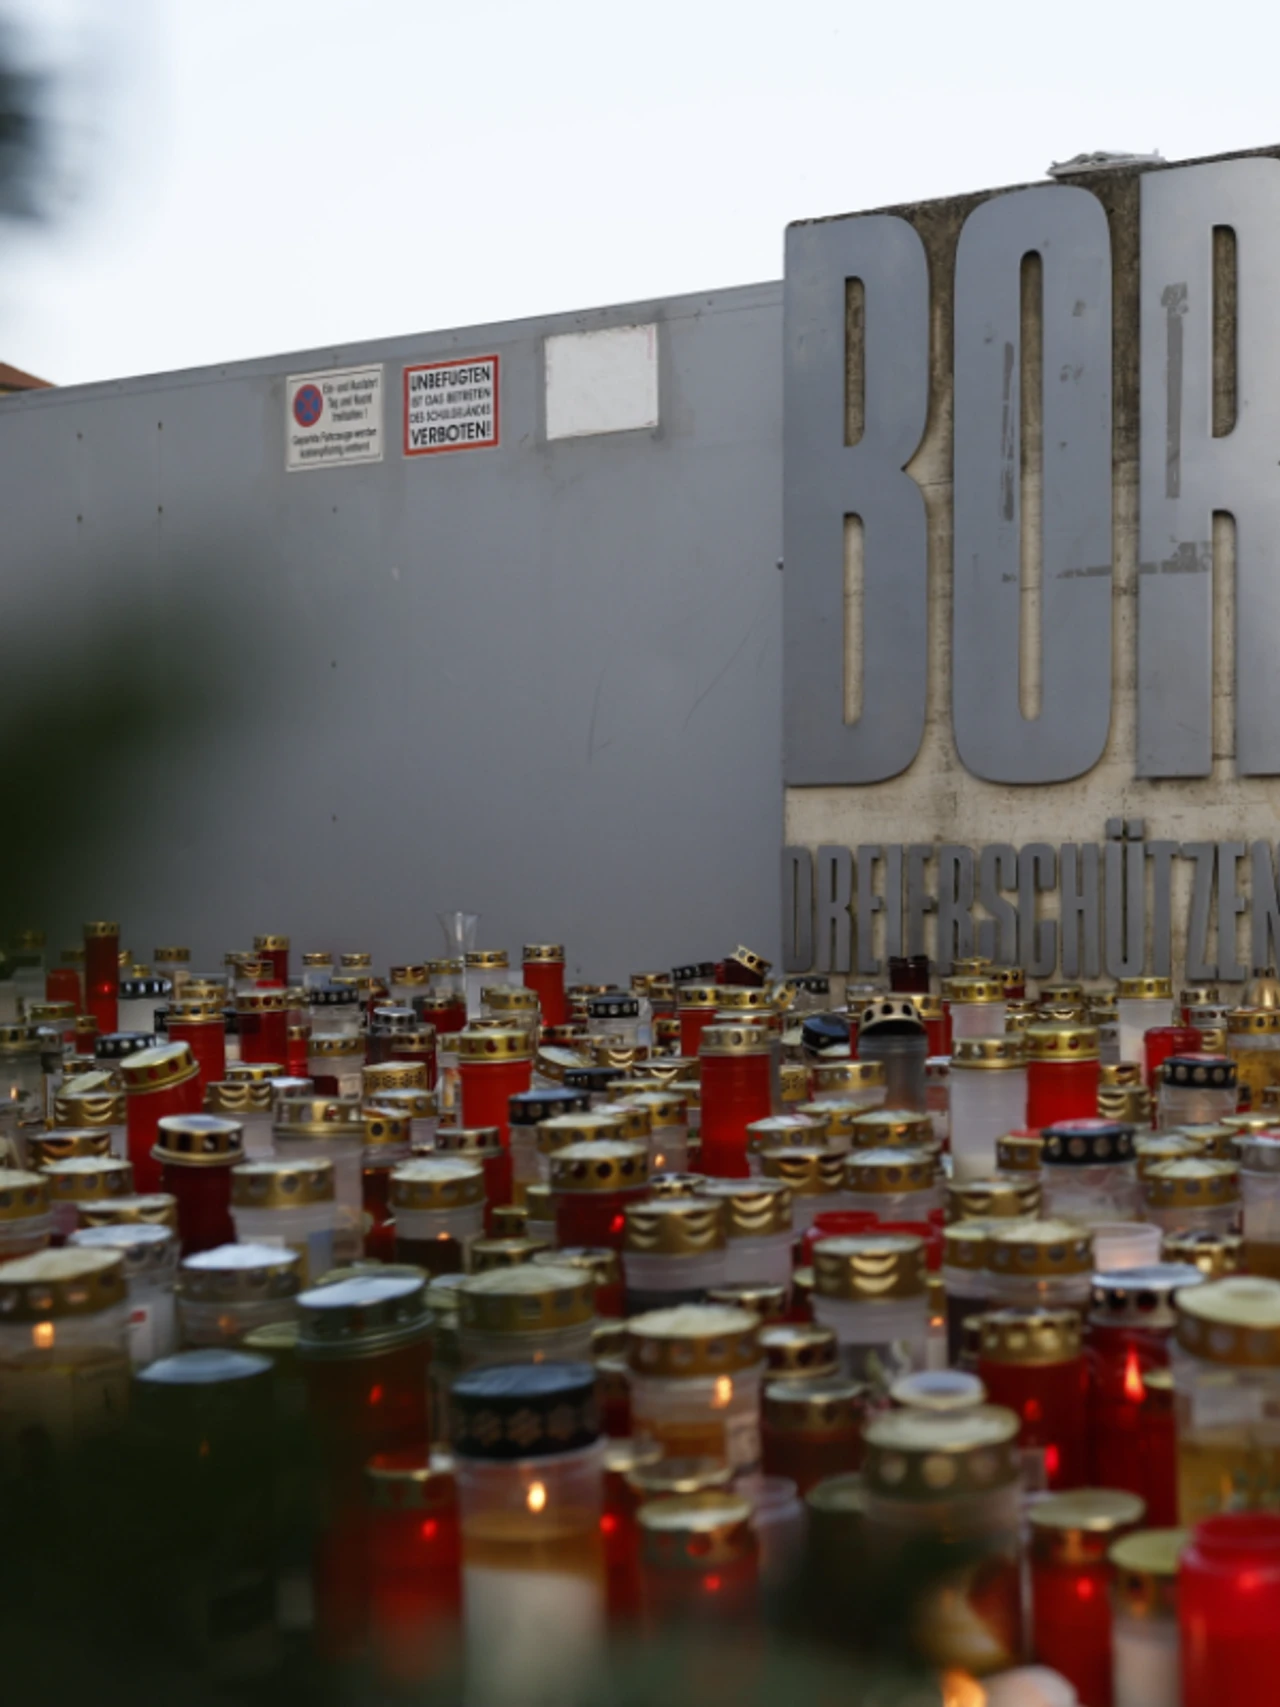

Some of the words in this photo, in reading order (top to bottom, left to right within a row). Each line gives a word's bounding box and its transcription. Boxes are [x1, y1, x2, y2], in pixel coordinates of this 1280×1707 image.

[410, 365, 490, 392] UNBEFUGTEN
[425, 393, 444, 406] DAS
[411, 420, 491, 446] VERBOTEN!
